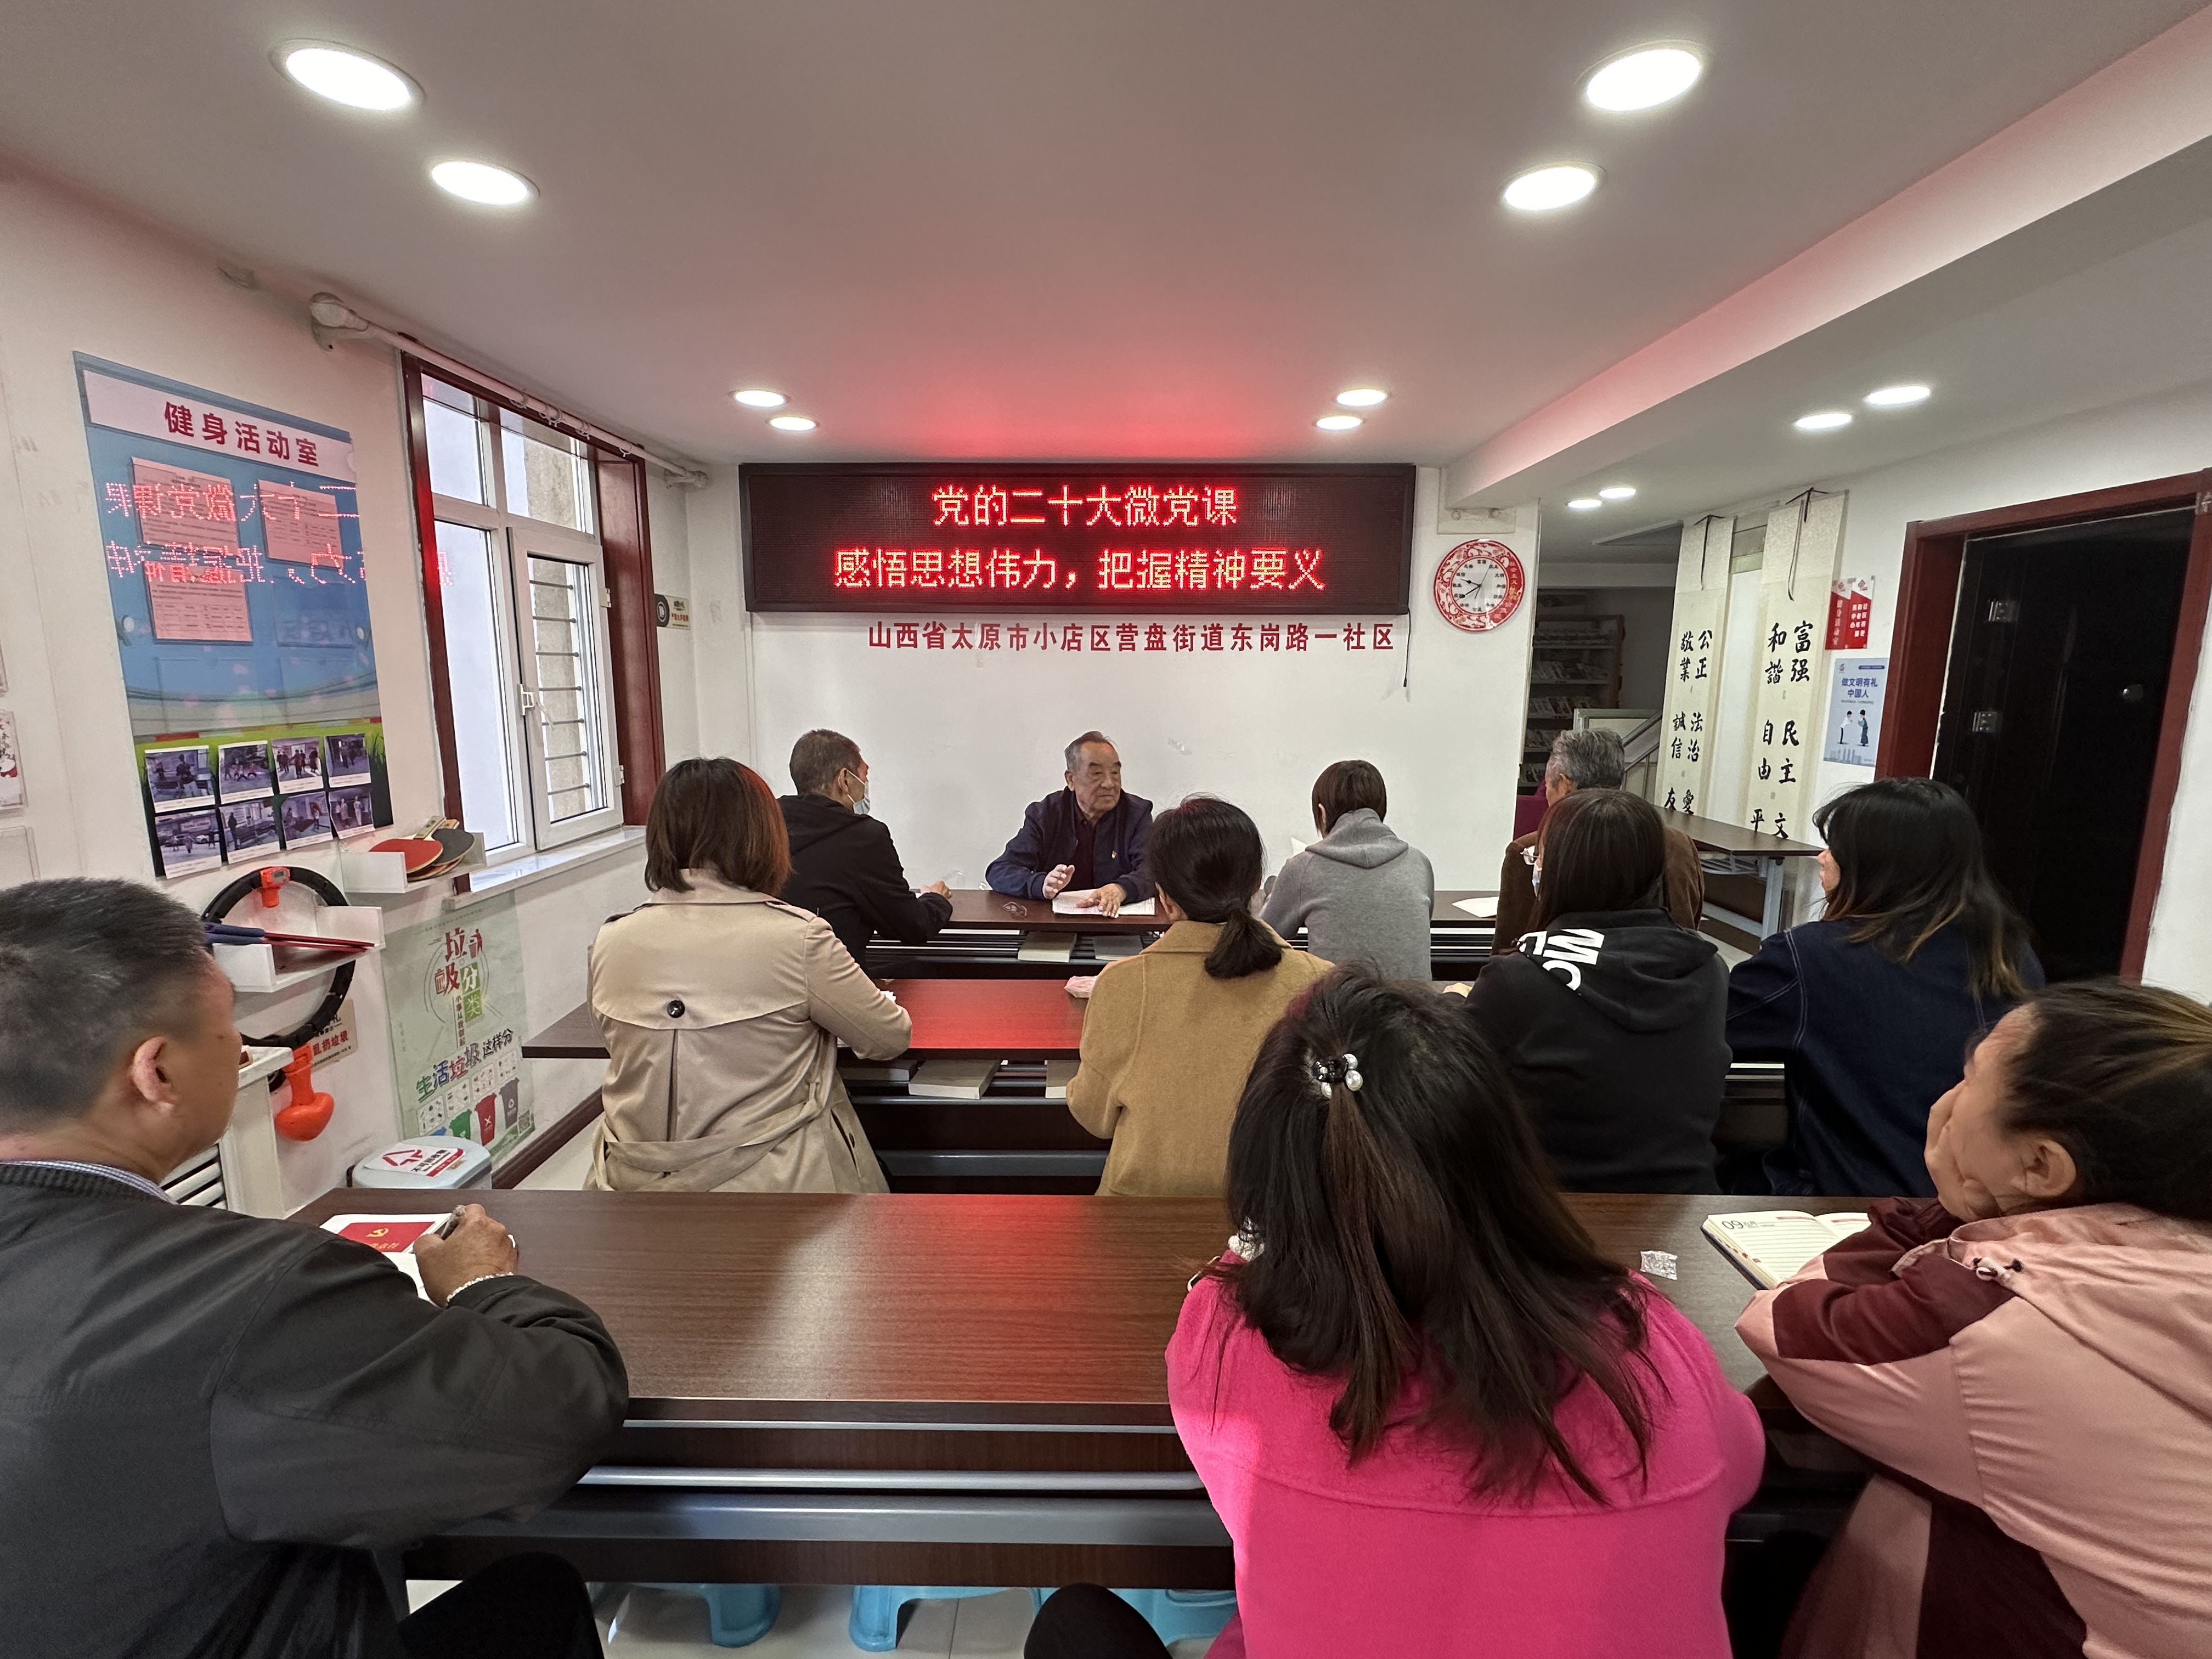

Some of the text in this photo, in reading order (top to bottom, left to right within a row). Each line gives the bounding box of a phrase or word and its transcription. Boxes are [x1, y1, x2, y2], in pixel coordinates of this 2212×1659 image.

[165, 401, 319, 467] 健身活动室
[931, 485, 1239, 528] 党的二十大微党课
[832, 548, 1327, 590] 感悟思想伟力，把握精神要义
[867, 620, 1395, 653] 山西省太原市小店区营盘街道东岗路一社区
[1695, 629, 1713, 679] 公正
[1842, 678, 1878, 687] 做文明有礼
[1847, 689, 1869, 698] 中国人
[1758, 719, 1773, 780] 自由
[1778, 720, 1799, 784] 民主
[1722, 1220, 1743, 1230] 09
